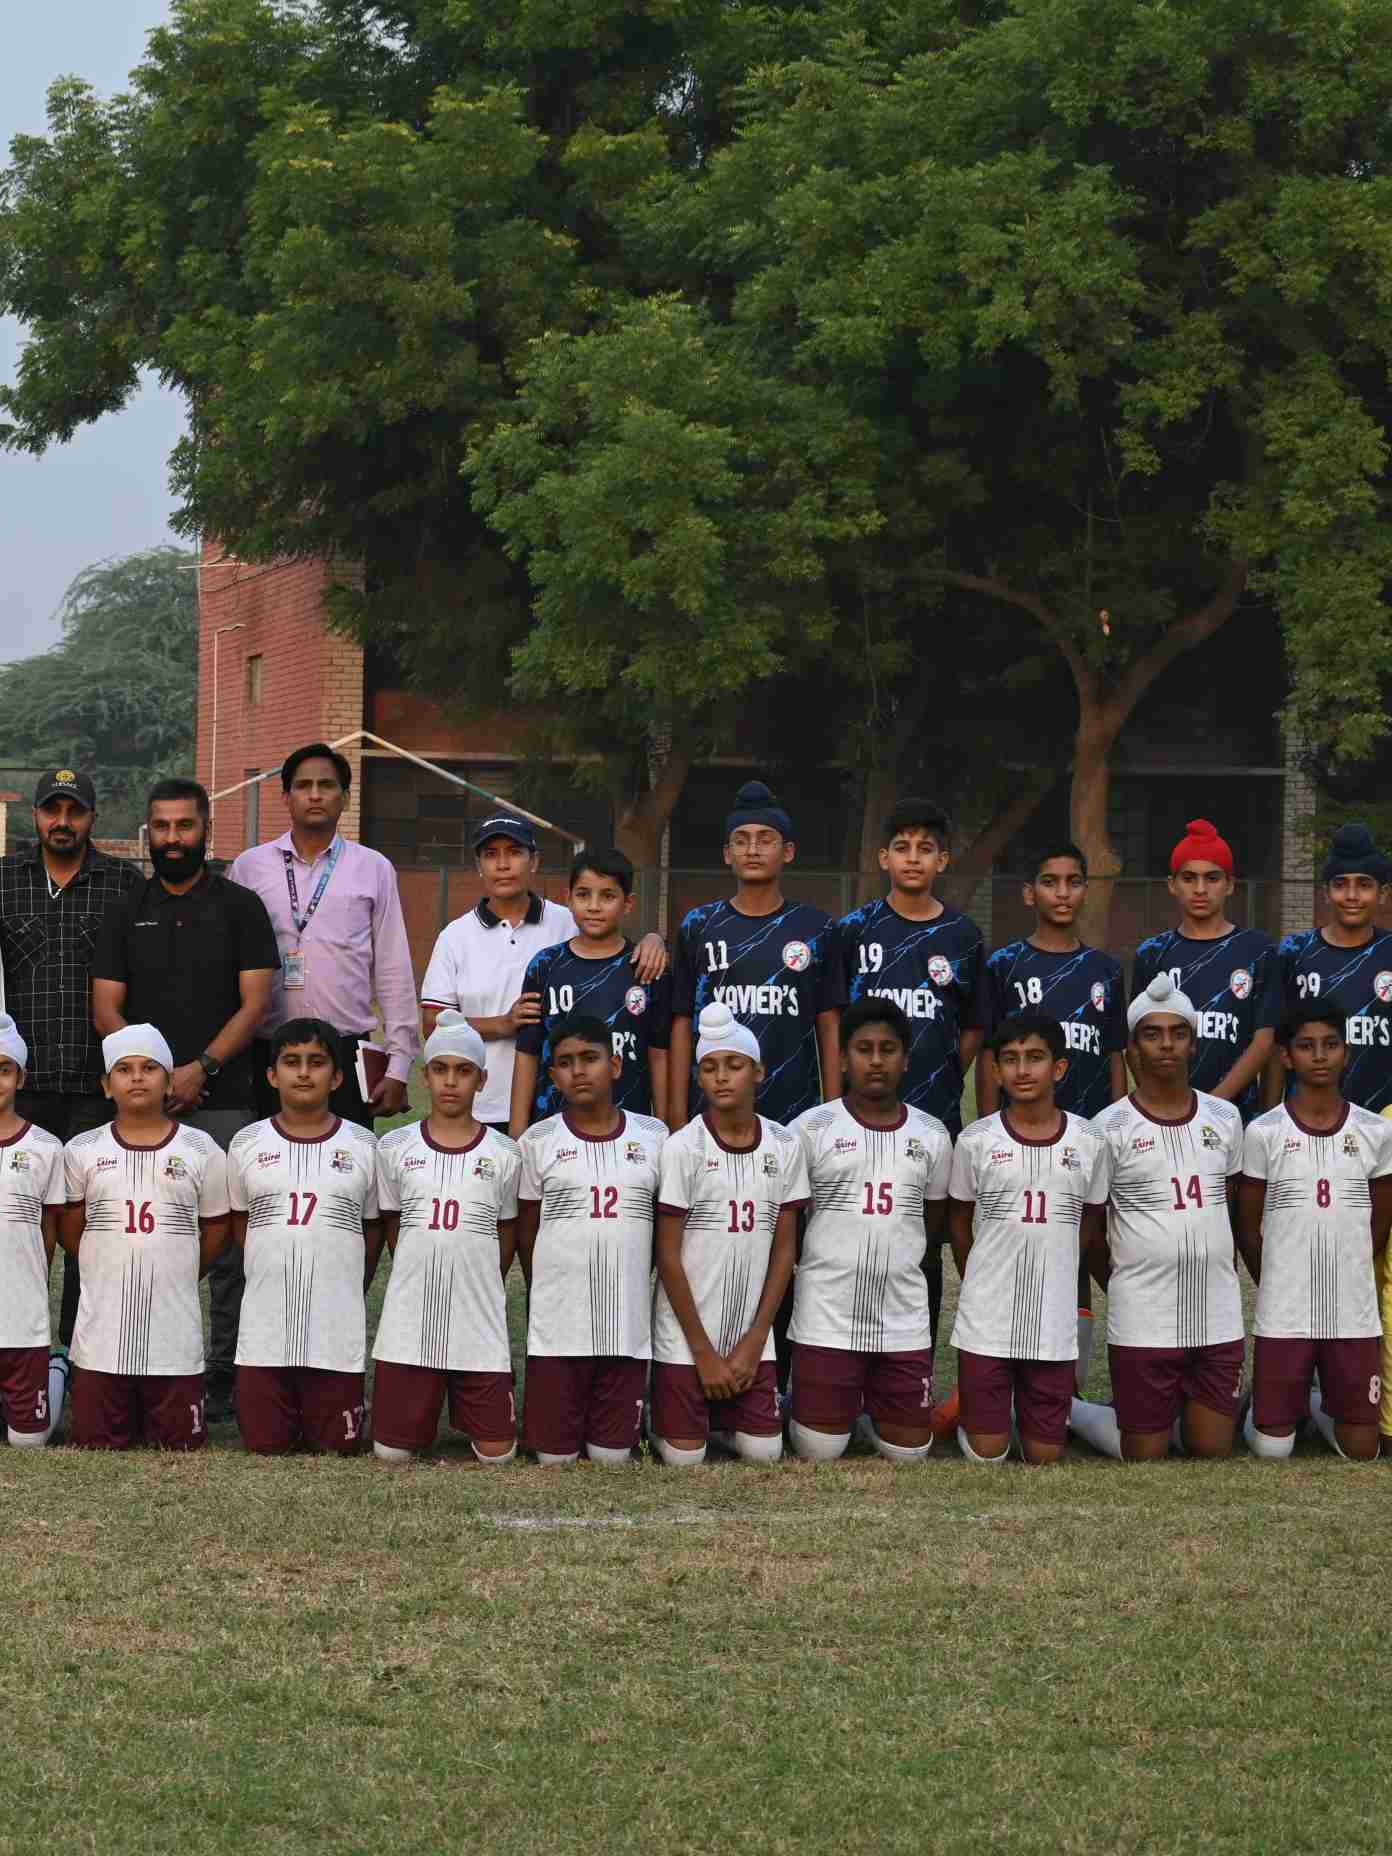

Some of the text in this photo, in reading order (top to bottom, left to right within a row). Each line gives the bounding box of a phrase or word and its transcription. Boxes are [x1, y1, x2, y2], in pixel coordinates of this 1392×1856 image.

[705, 941, 729, 972] 11
[858, 943, 883, 973] 19
[549, 985, 573, 1015] 10
[1014, 977, 1043, 1008] 18
[1194, 1011, 1239, 1043] IER'S
[286, 1192, 318, 1225] 17
[590, 1186, 618, 1218] 12
[862, 1182, 893, 1215] 15
[1021, 1190, 1048, 1224] 11
[1171, 1175, 1204, 1211] 14
[1316, 1178, 1331, 1209] 8
[124, 1200, 155, 1233] 16
[428, 1198, 459, 1231] 10
[727, 1200, 755, 1232] 13
[35, 1389, 48, 1419] 5
[1368, 1375, 1381, 1405] 8
